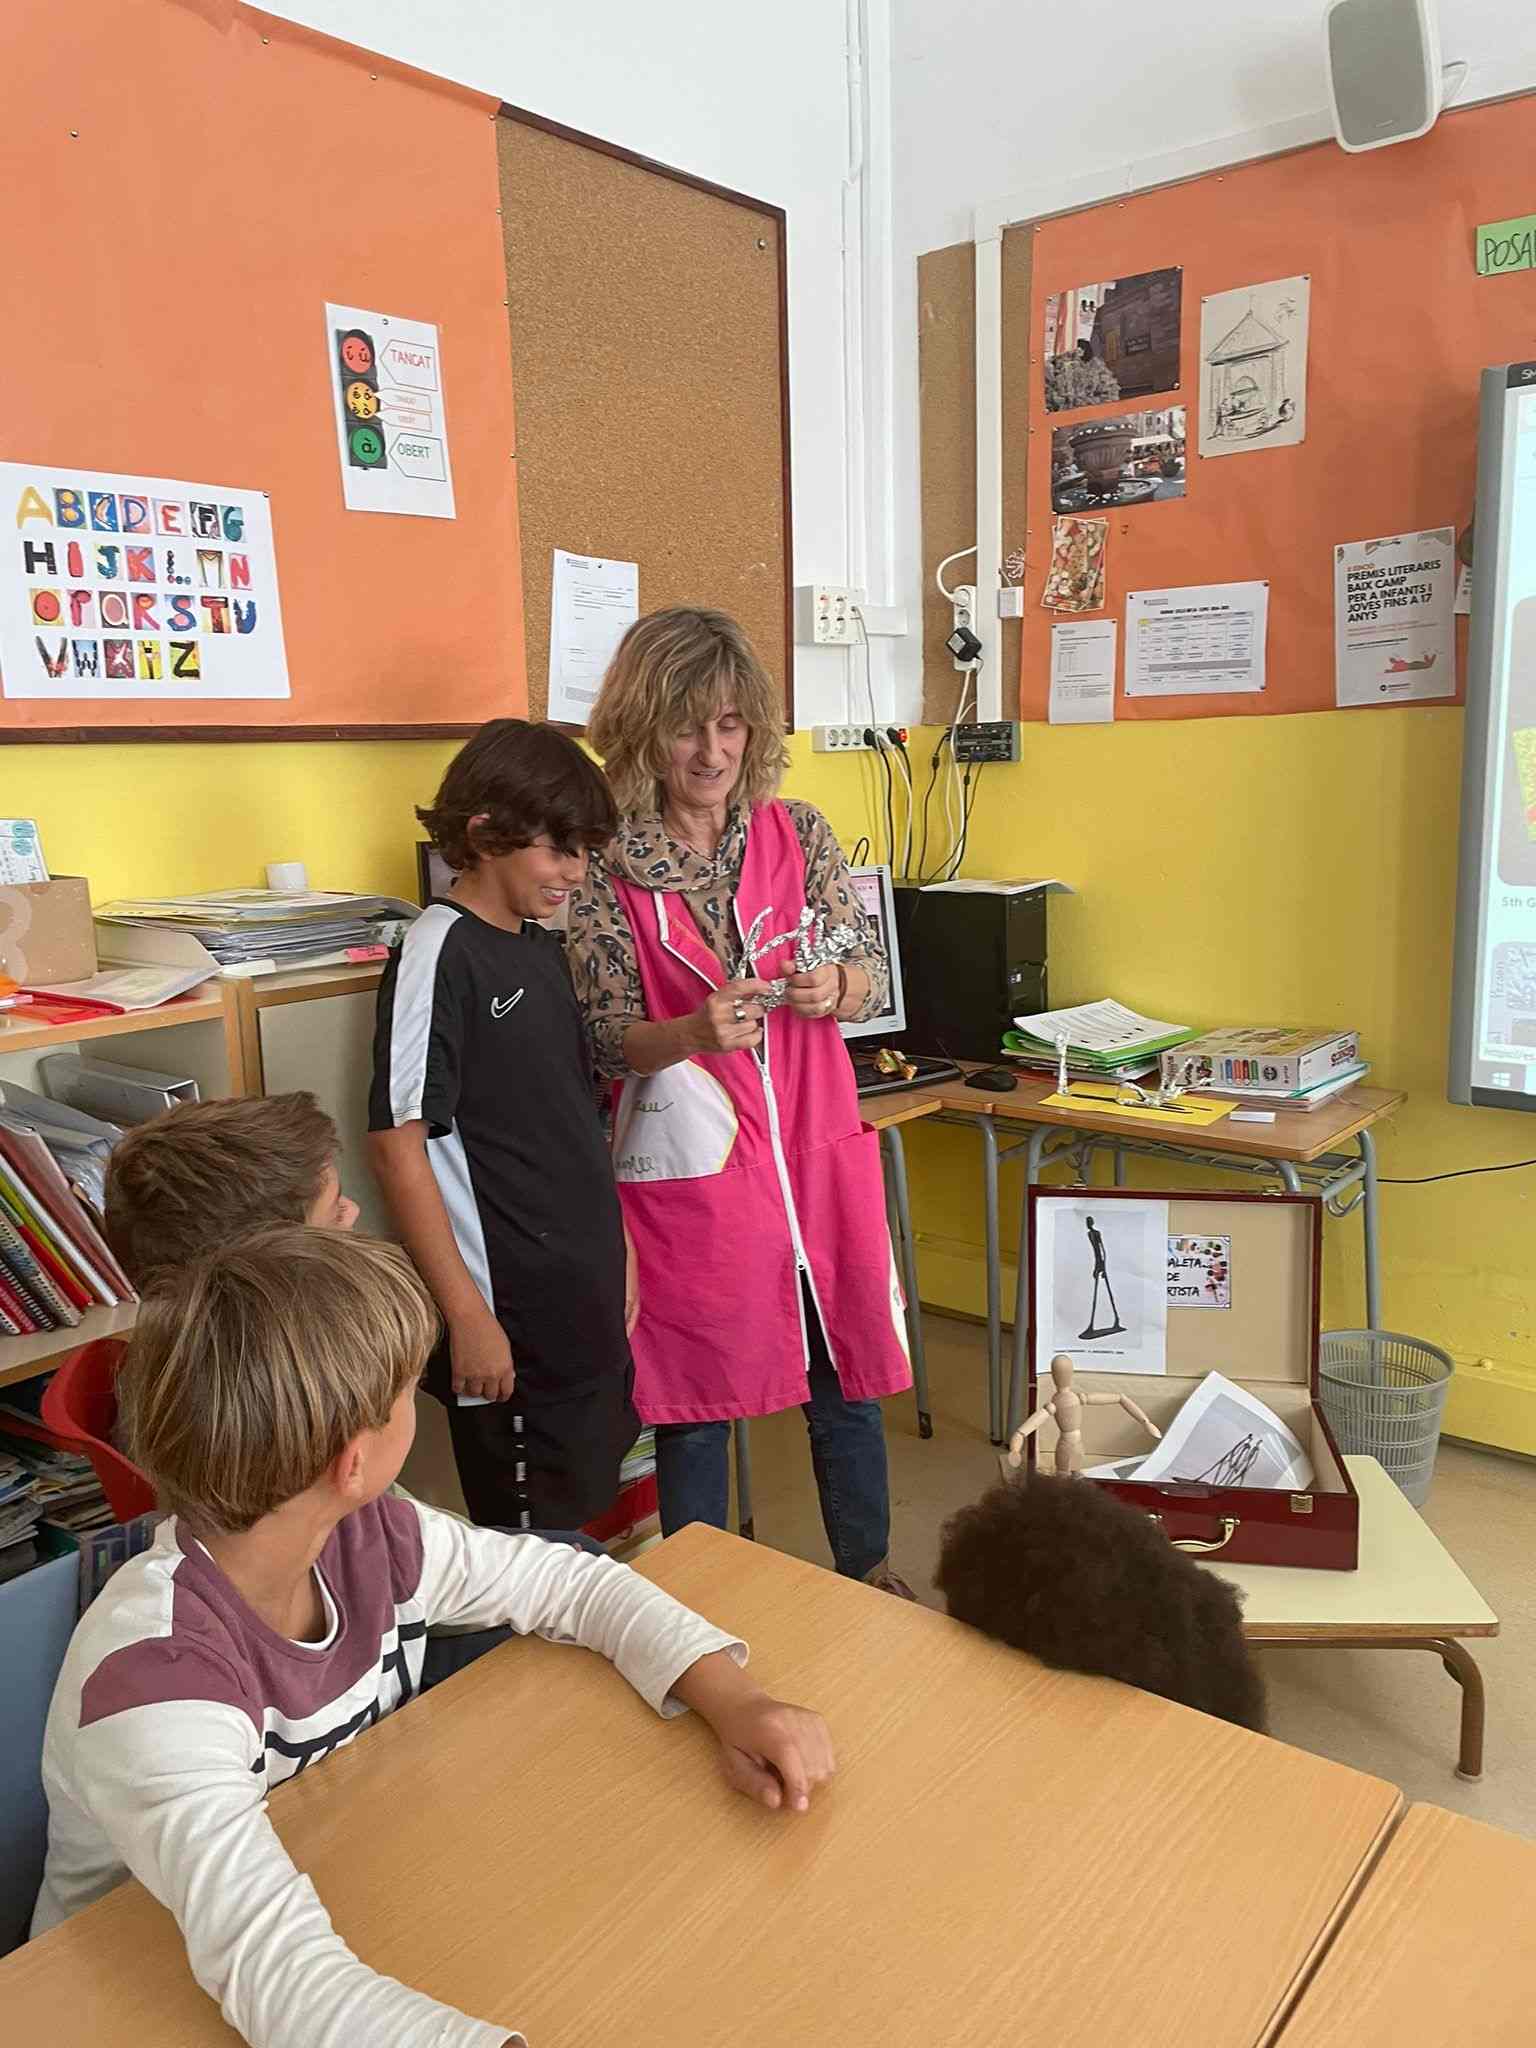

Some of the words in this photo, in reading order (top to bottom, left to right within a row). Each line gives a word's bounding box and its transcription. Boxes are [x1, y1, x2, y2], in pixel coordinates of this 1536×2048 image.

[1484, 230, 1536, 272] POSA
[390, 349, 432, 369] TANCAT
[397, 441, 431, 460] OBERT
[1347, 568, 1386, 582] PREMIS
[1388, 560, 1441, 576] LITERARIS
[1347, 581, 1373, 593] BAIX
[1375, 576, 1407, 588] CAMP
[1347, 592, 1367, 603] PER
[1370, 592, 1378, 600] A
[1380, 584, 1426, 599] INFANTS
[1347, 601, 1381, 613] JOVES
[1384, 597, 1408, 608] FINS
[1410, 595, 1419, 604] A
[1421, 593, 1433, 603] 17
[1347, 611, 1378, 623] ANYS
[1167, 1257, 1202, 1269] ALETA
[1167, 1286, 1200, 1297] RTISTA
